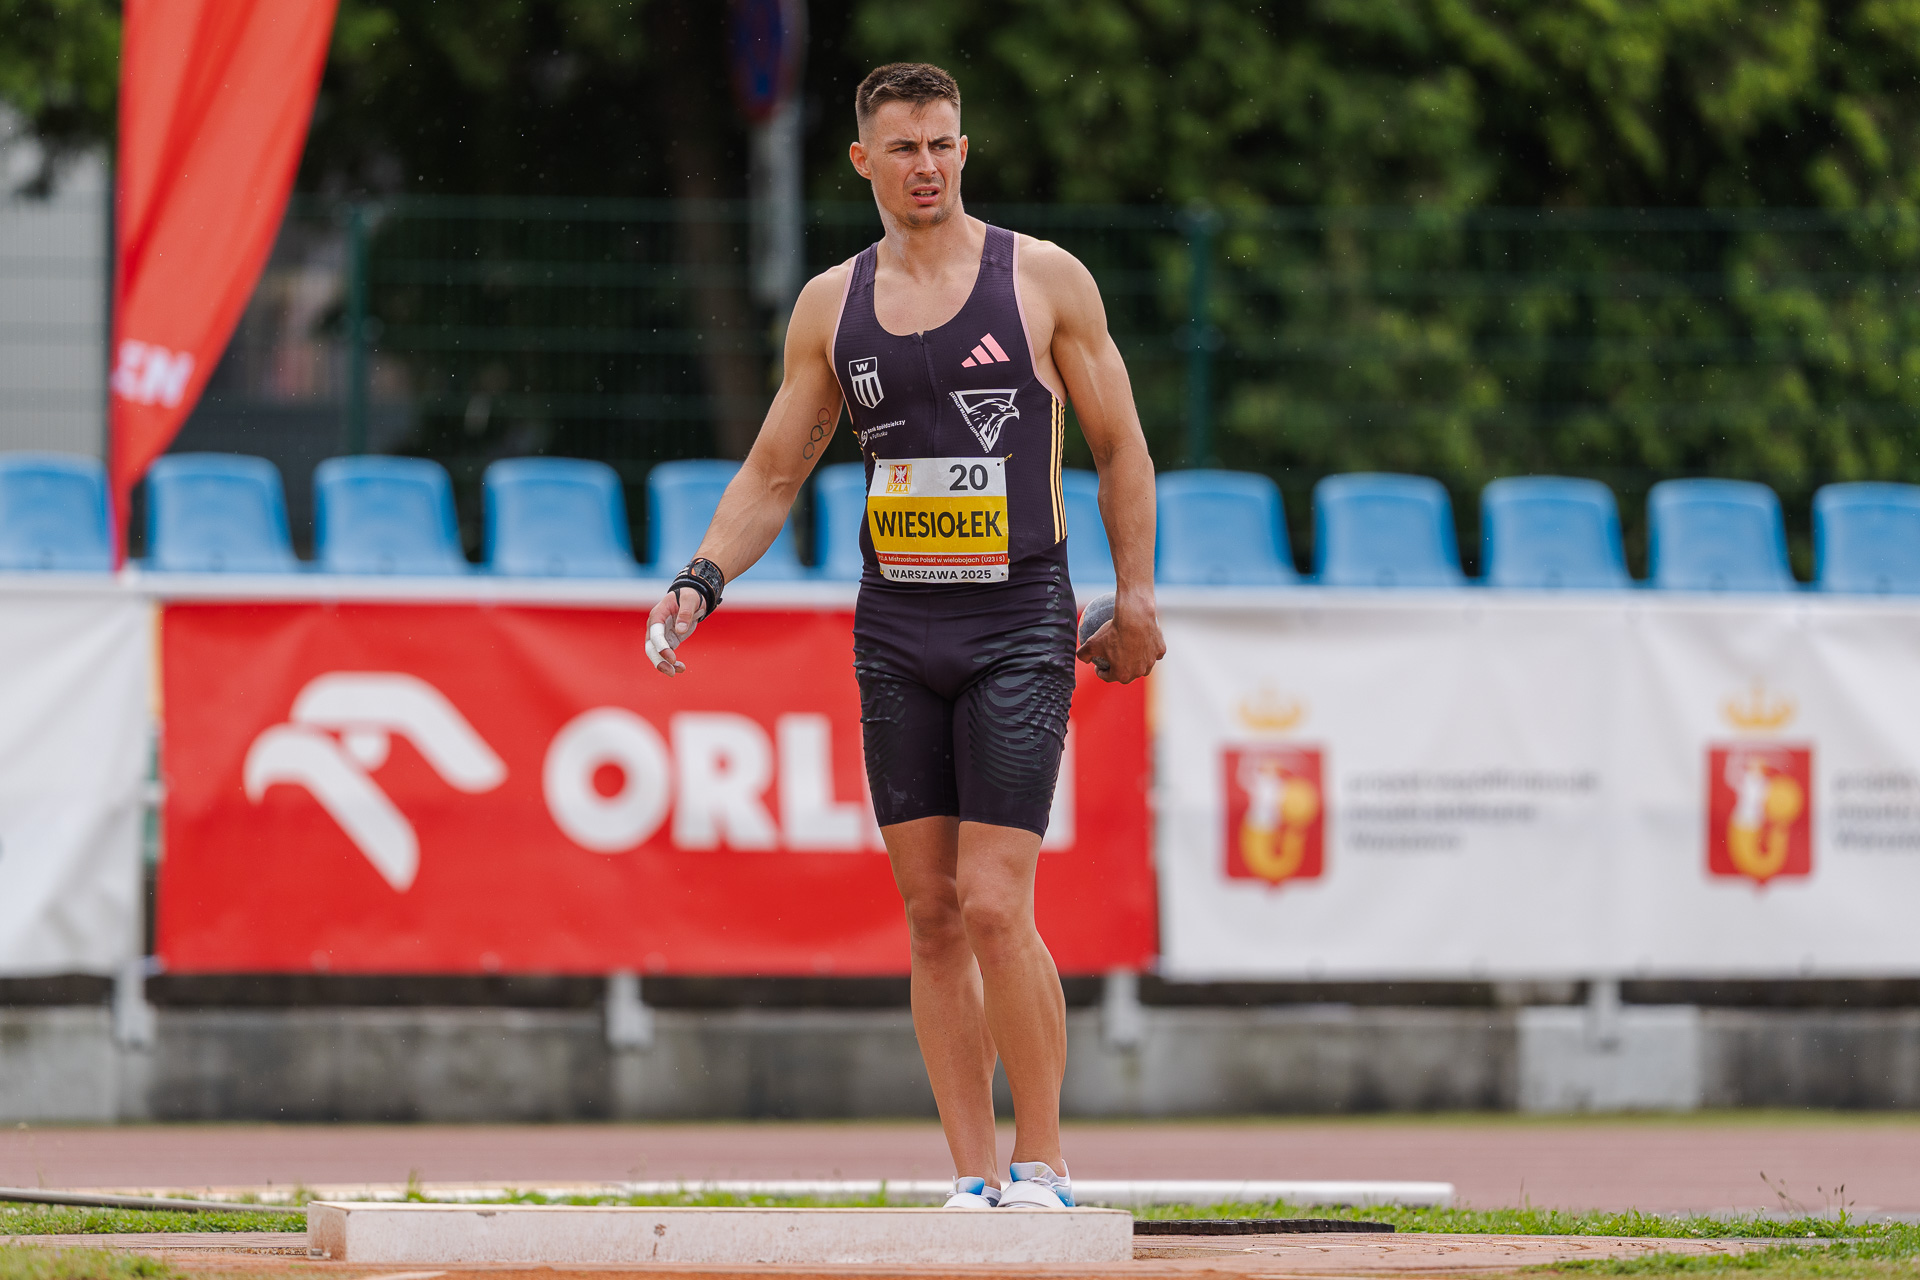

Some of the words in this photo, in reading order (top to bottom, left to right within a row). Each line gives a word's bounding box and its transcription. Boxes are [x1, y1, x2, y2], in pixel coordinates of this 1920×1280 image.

[855, 362, 869, 373] W
[949, 464, 989, 491] 20
[873, 510, 1003, 538] WIESIOŁEK
[943, 557, 980, 565] wielobojach
[889, 568, 959, 580] WARSZAWA
[960, 569, 992, 580] 2025
[543, 707, 1075, 853] ORL
